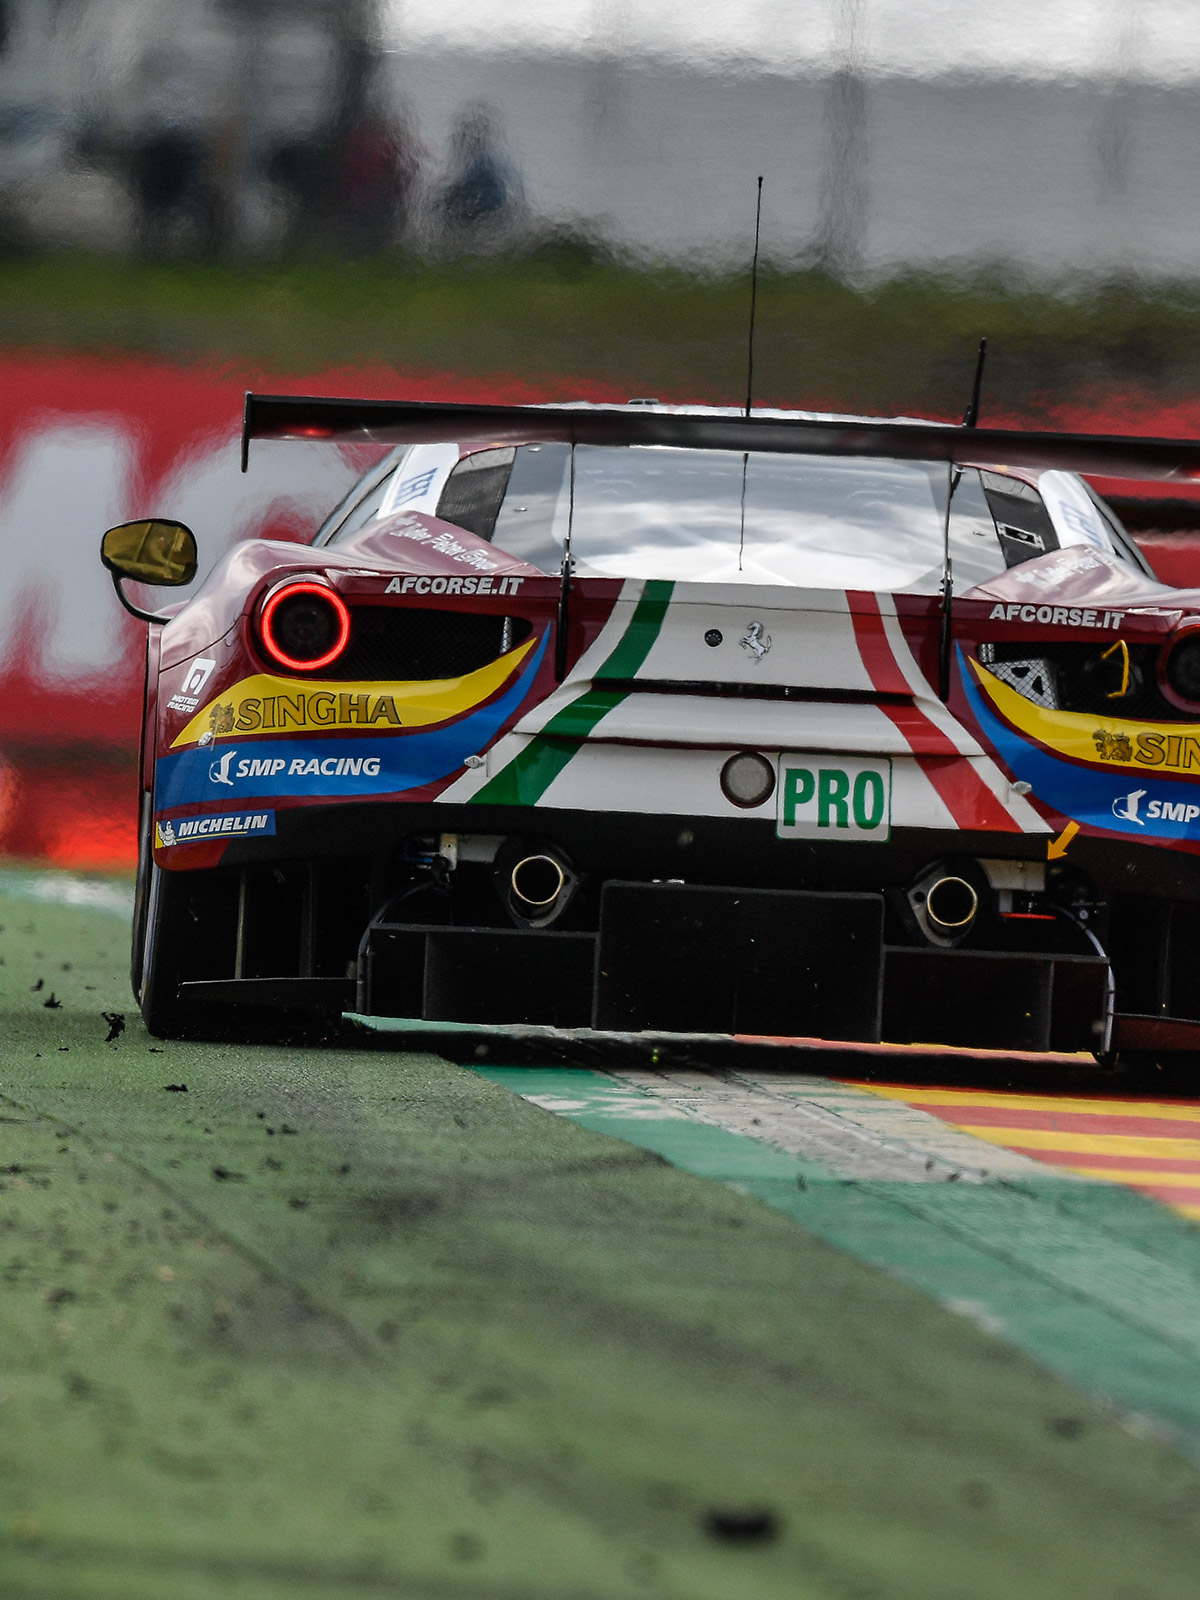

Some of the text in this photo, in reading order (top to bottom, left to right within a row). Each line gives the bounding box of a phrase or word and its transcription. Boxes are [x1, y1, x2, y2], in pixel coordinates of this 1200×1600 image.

[384, 577, 524, 595] AFCORSE.IT
[989, 604, 1125, 629] AFCORSE.IT
[166, 701, 196, 713] RACING
[171, 694, 199, 706] MOTEGI
[235, 692, 402, 732] SINGHA
[236, 757, 381, 778] SMP RACING
[783, 768, 884, 830] PRO
[1147, 801, 1200, 823] SMP
[178, 814, 268, 837] MICHELIN
